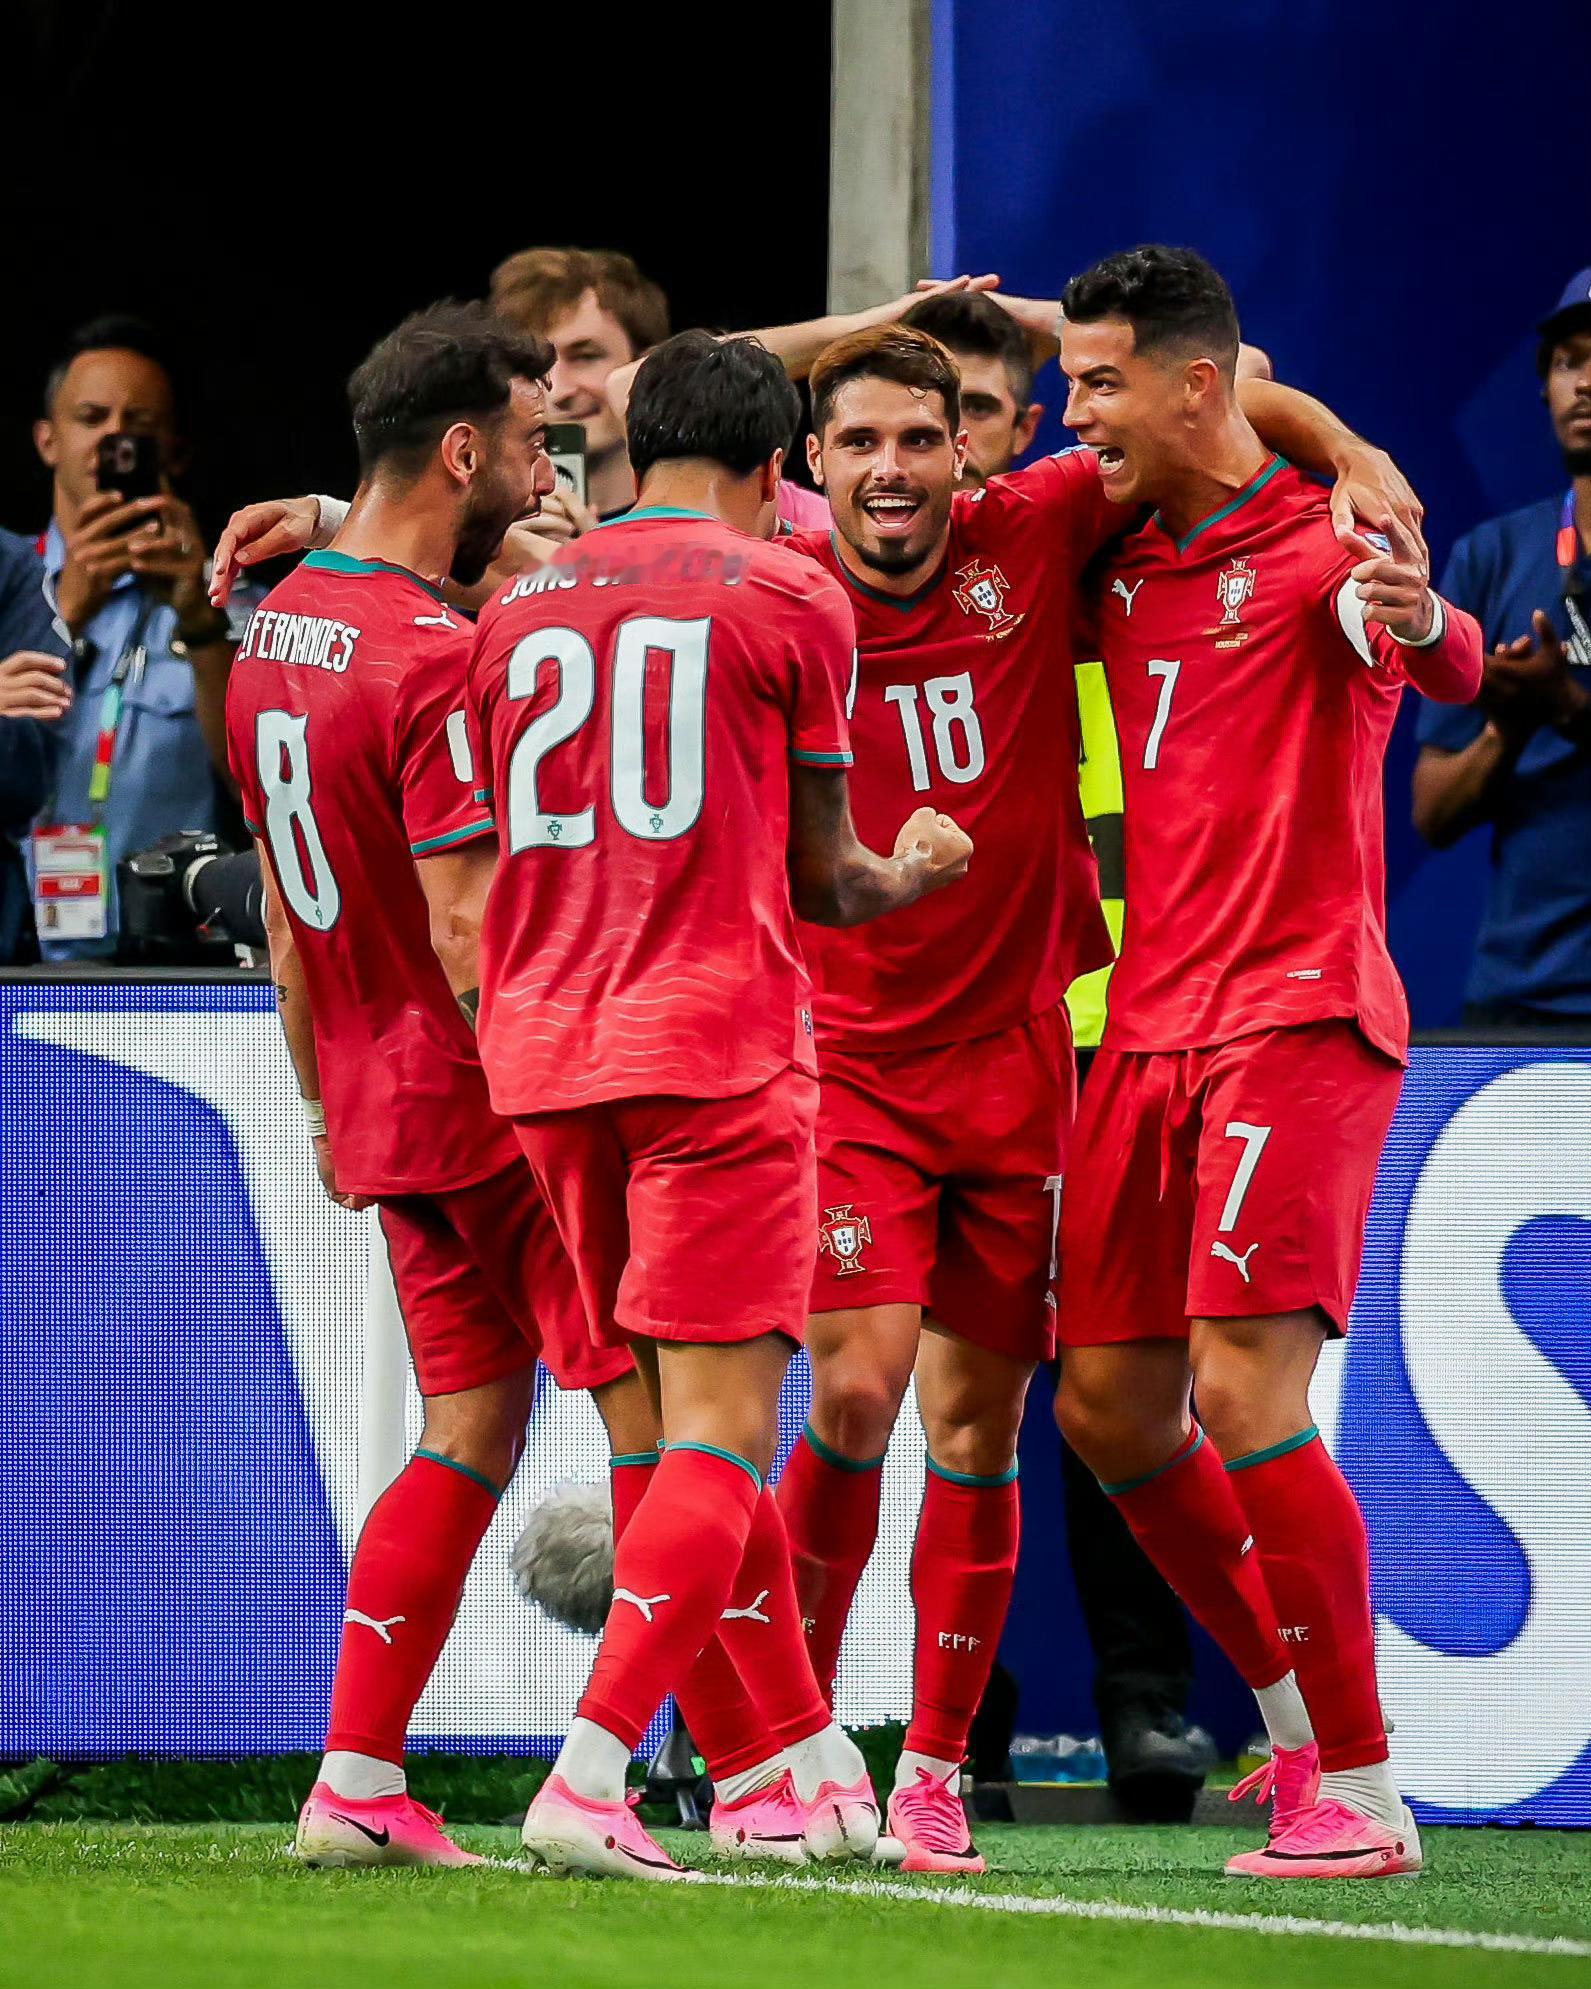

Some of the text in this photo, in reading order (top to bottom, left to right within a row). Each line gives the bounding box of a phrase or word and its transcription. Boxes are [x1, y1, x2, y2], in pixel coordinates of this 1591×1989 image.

[507, 615, 711, 856] 20
[885, 671, 985, 792] 18
[1143, 659, 1181, 770] 7
[256, 710, 341, 931] 8
[1217, 1122, 1272, 1232] 7
